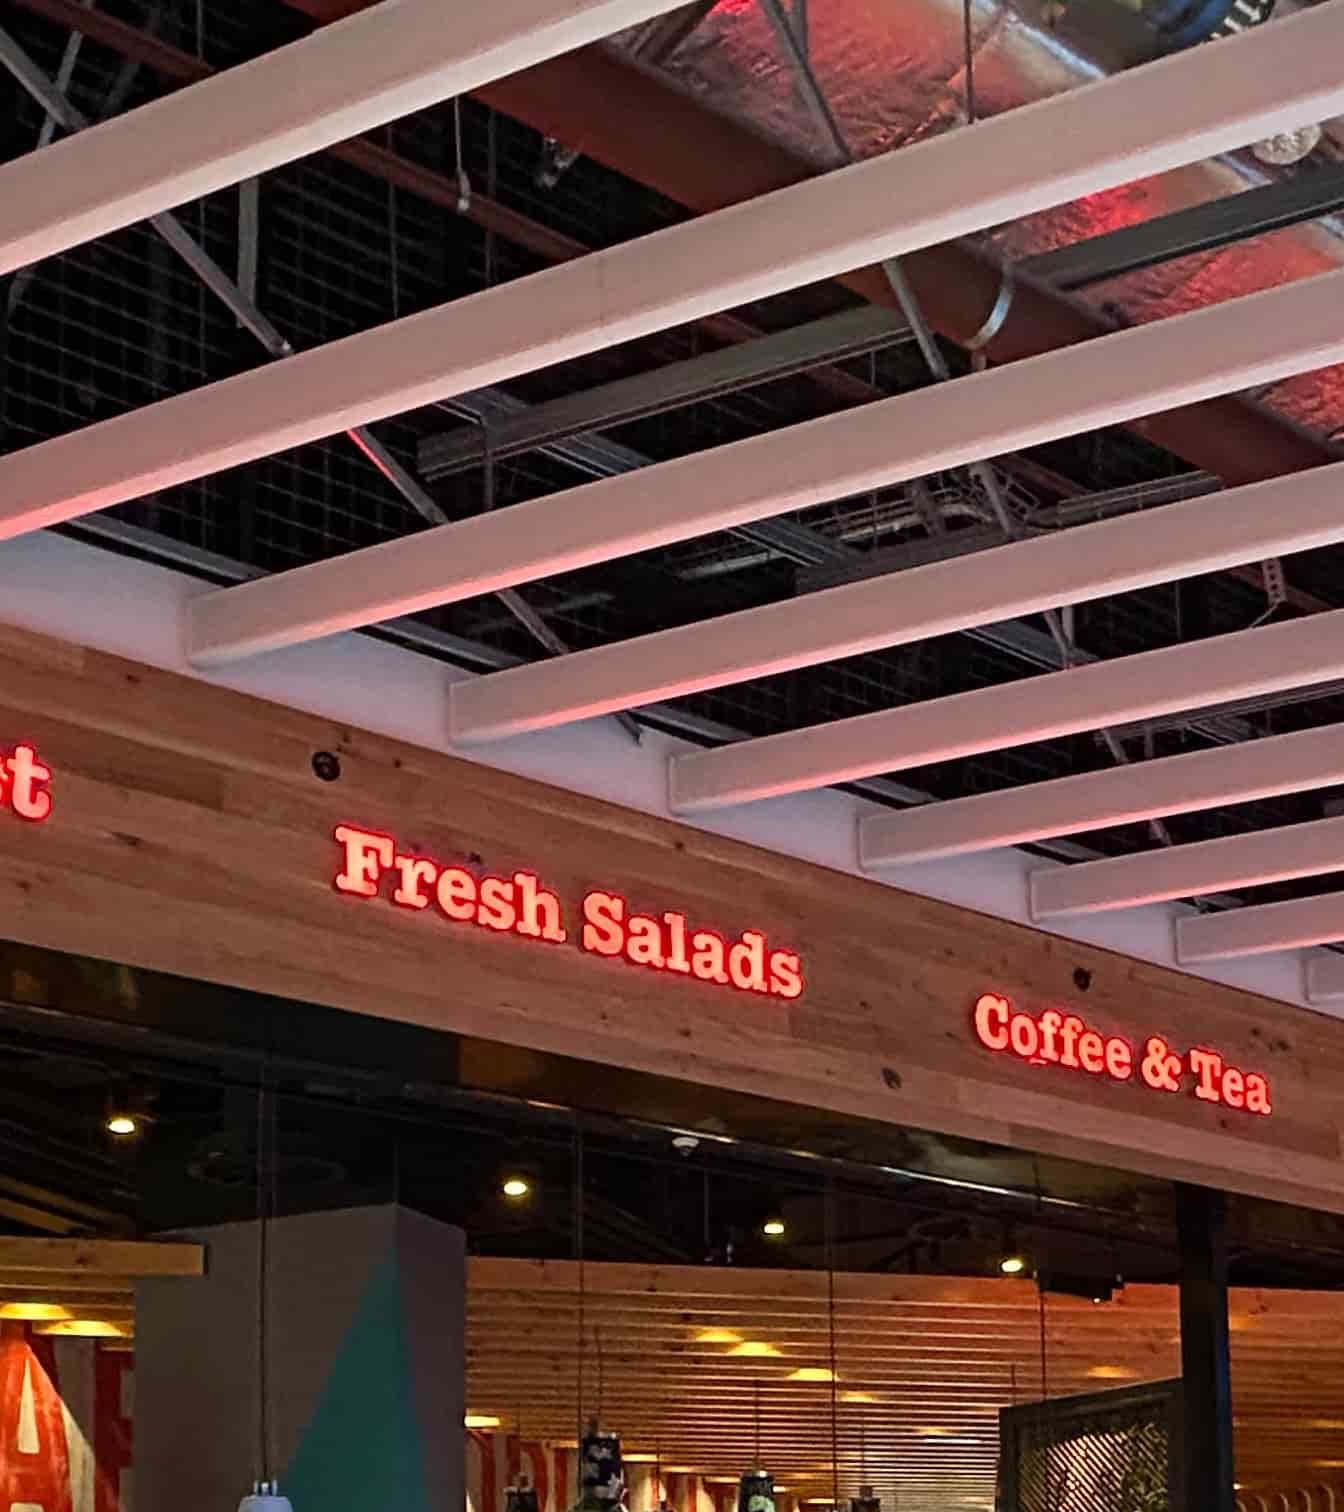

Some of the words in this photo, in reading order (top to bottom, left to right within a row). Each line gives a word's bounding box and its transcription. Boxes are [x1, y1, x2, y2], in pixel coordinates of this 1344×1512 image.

[333, 824, 566, 945] Fresh
[582, 891, 804, 999] Salads
[973, 993, 1132, 1081] Coffee
[1140, 1036, 1183, 1092] &
[1190, 1047, 1272, 1116] Tea
